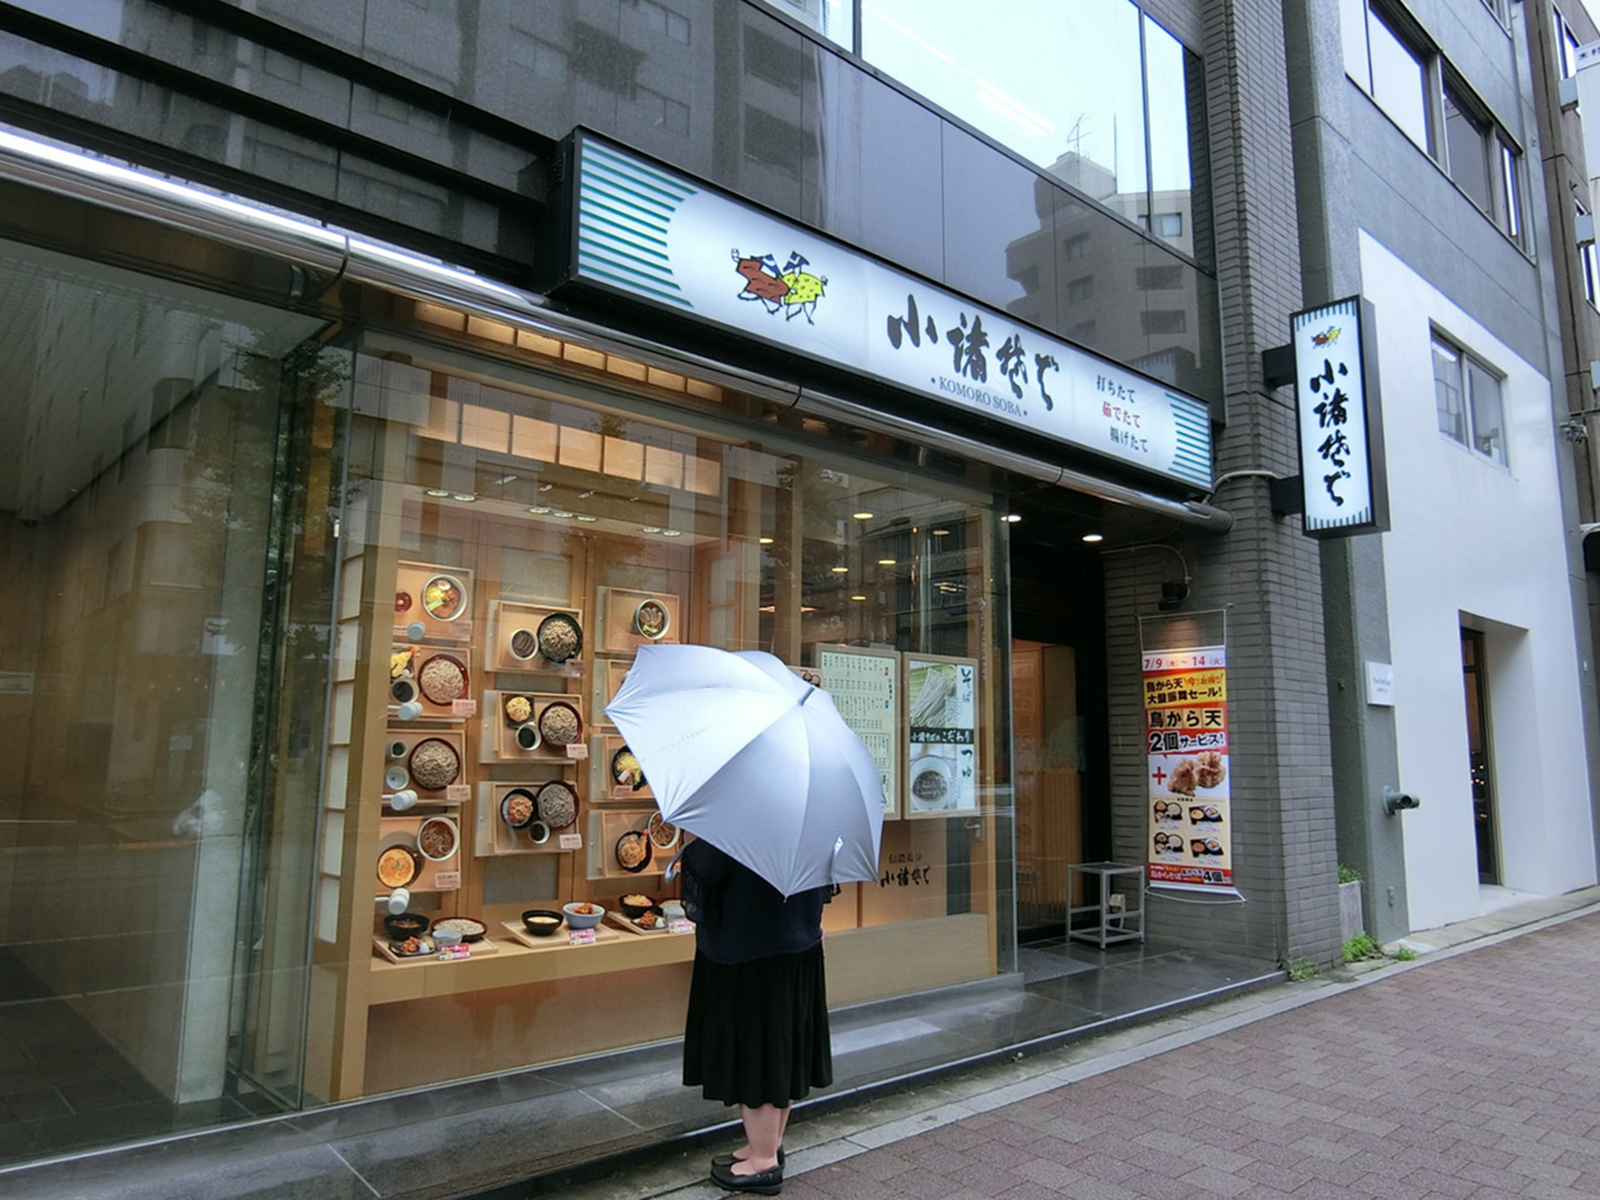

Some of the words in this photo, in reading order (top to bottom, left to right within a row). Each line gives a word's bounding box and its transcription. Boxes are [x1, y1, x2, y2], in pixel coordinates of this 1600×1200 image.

[939, 376, 991, 406] KOMORO
[992, 396, 1022, 417] SOBA
[1097, 374, 1135, 404] 打ちたて
[1102, 400, 1141, 429] 茹でたて
[1110, 426, 1148, 453] 揚げたて
[1150, 710, 1221, 728] 鳥から天
[1150, 732, 1224, 752] 2個サービス!
